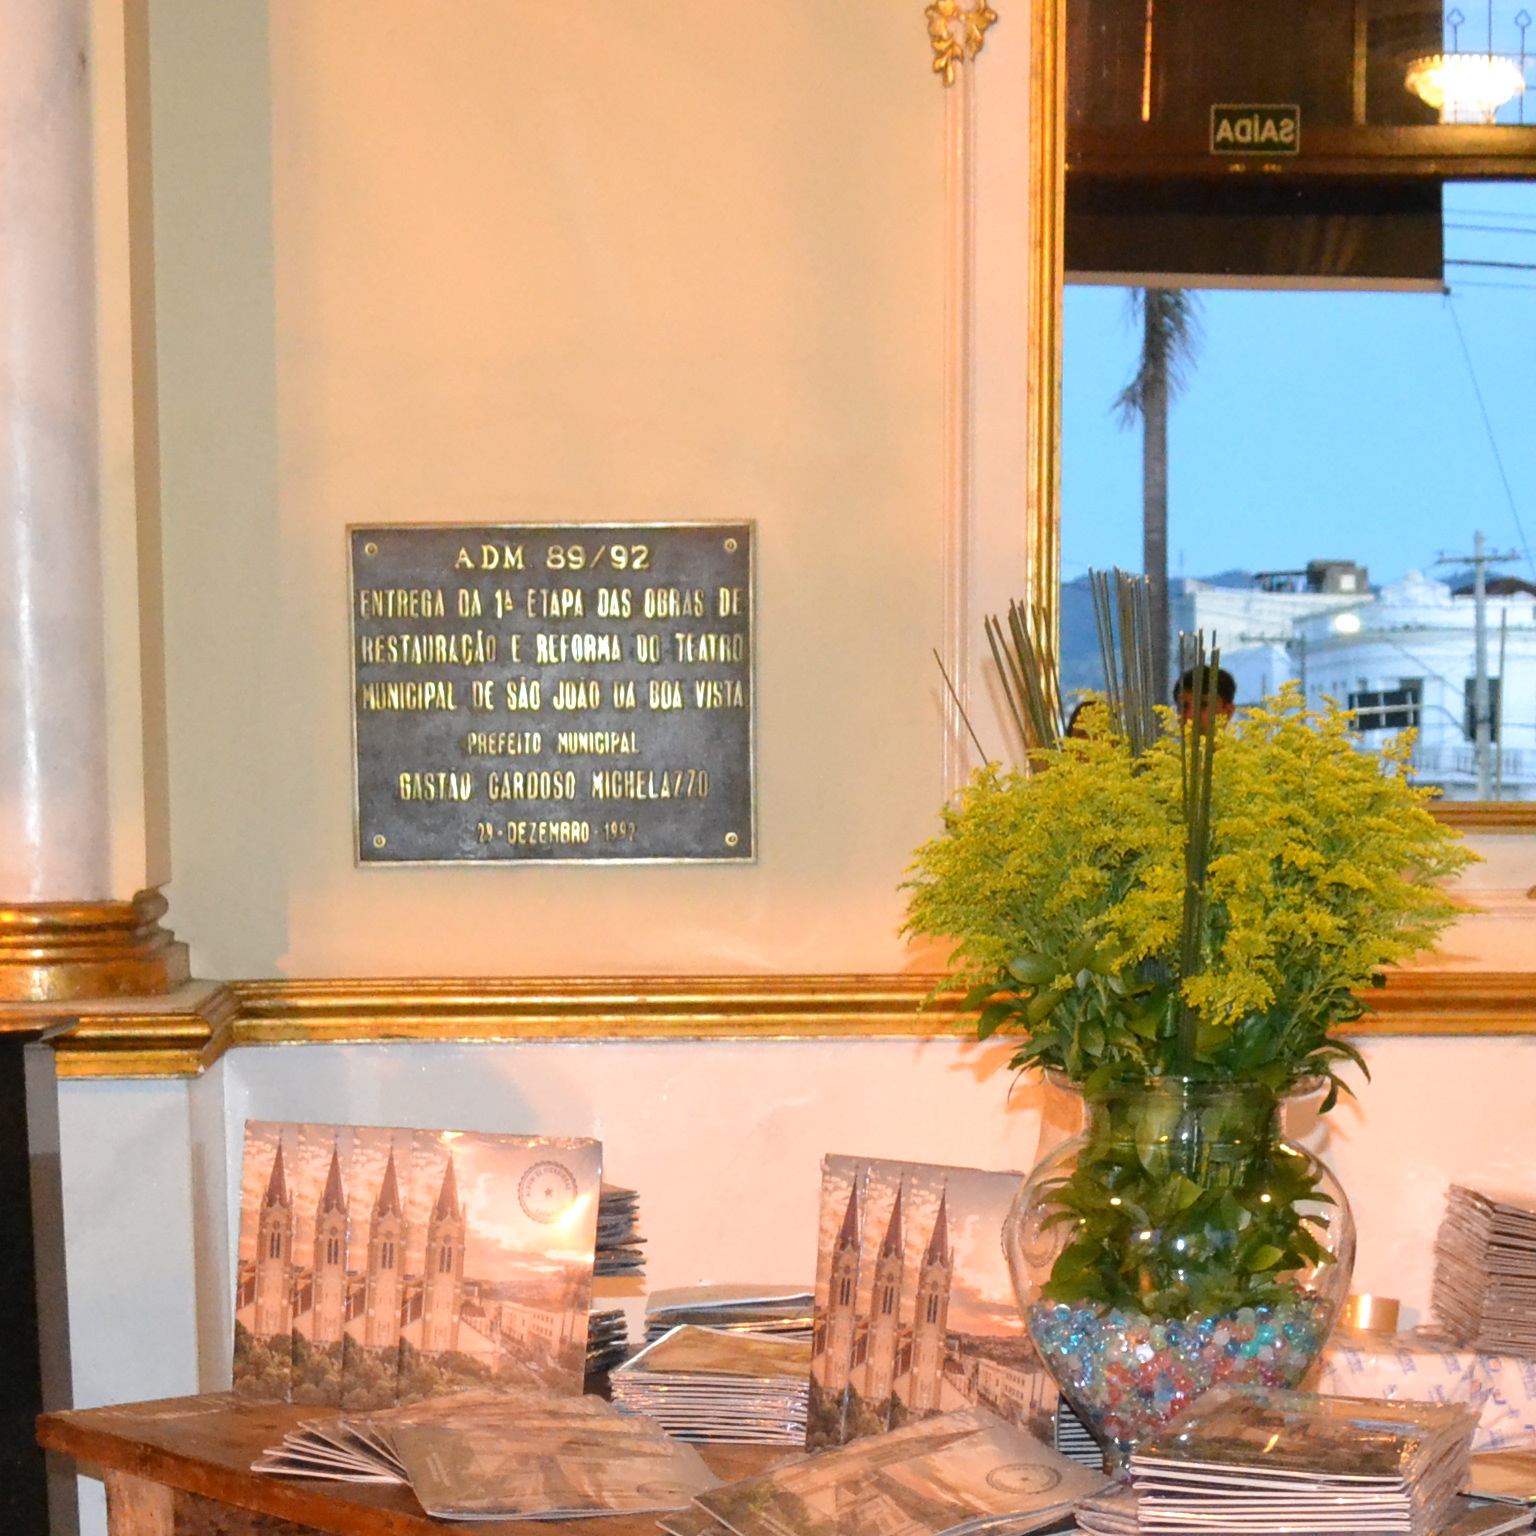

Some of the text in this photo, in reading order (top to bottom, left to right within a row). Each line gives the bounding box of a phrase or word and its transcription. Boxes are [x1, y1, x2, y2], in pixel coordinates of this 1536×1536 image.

[454, 544, 650, 570] ADM 89/92
[360, 588, 445, 618] ENTREGA
[458, 588, 482, 618] DA
[527, 587, 584, 618] ETAPA
[597, 587, 632, 618] DAS
[644, 587, 705, 618] OBRAS
[719, 586, 743, 618] DE
[361, 629, 744, 666] RESTAURAÇÃO E REFORMA DO TEATRO
[362, 675, 744, 710] MUNICIPAL DE SÃO JOÃO DA BOA VISTA
[467, 731, 640, 755] PREFEITO MUNICIPAL
[399, 767, 709, 801] GASTÃO CARDOSO MICHELAZZO
[507, 821, 590, 844] DEZEMBRO
